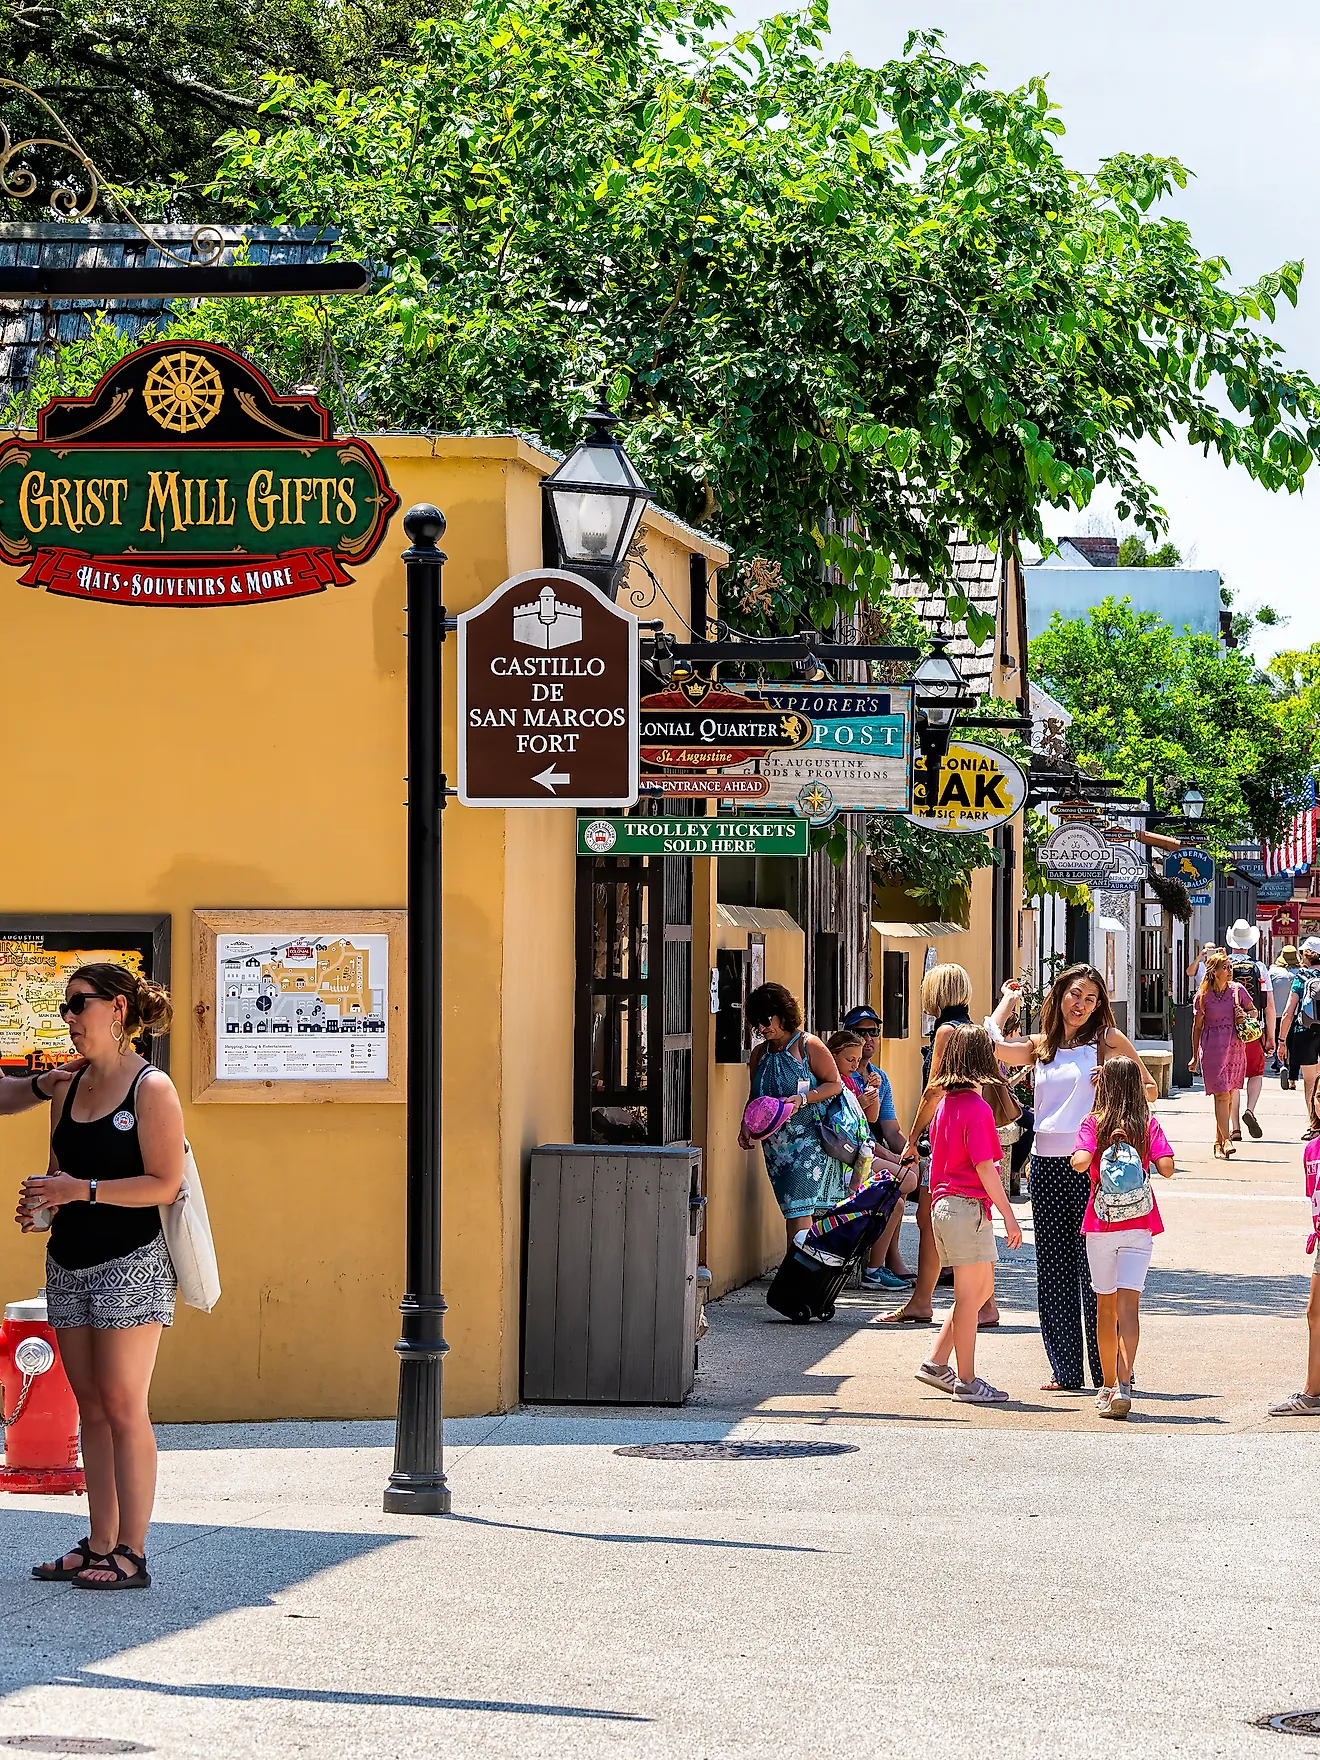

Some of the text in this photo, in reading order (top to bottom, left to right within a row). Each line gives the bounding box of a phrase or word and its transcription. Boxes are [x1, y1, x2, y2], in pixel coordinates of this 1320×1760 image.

[19, 469, 357, 543] GRIST MILL GIFTS
[76, 566, 294, 598] HATS SOUVENIRS & MORE
[490, 657, 605, 677] CASTILLO
[531, 683, 564, 702] DE
[762, 696, 879, 713] XPLORER'S
[470, 708, 625, 728] SAN MARCOS
[700, 719, 778, 742] QUARTER
[813, 725, 898, 746] POST
[516, 734, 579, 753] FORT
[656, 750, 733, 764] St. Augustine
[764, 758, 783, 767] ST.
[914, 757, 999, 772] CLONIAL
[743, 768, 888, 780] GODS & PROVISIONS
[663, 781, 721, 792] ENTRANCE
[724, 781, 763, 792] AHEAD
[960, 811, 989, 820] PARK
[624, 823, 713, 837] TROLLEY
[716, 824, 797, 837] TICKETS
[663, 839, 756, 852] SOLD HERE
[1040, 849, 1111, 861] SEAFOOD
[1172, 850, 1208, 862] TABERNA
